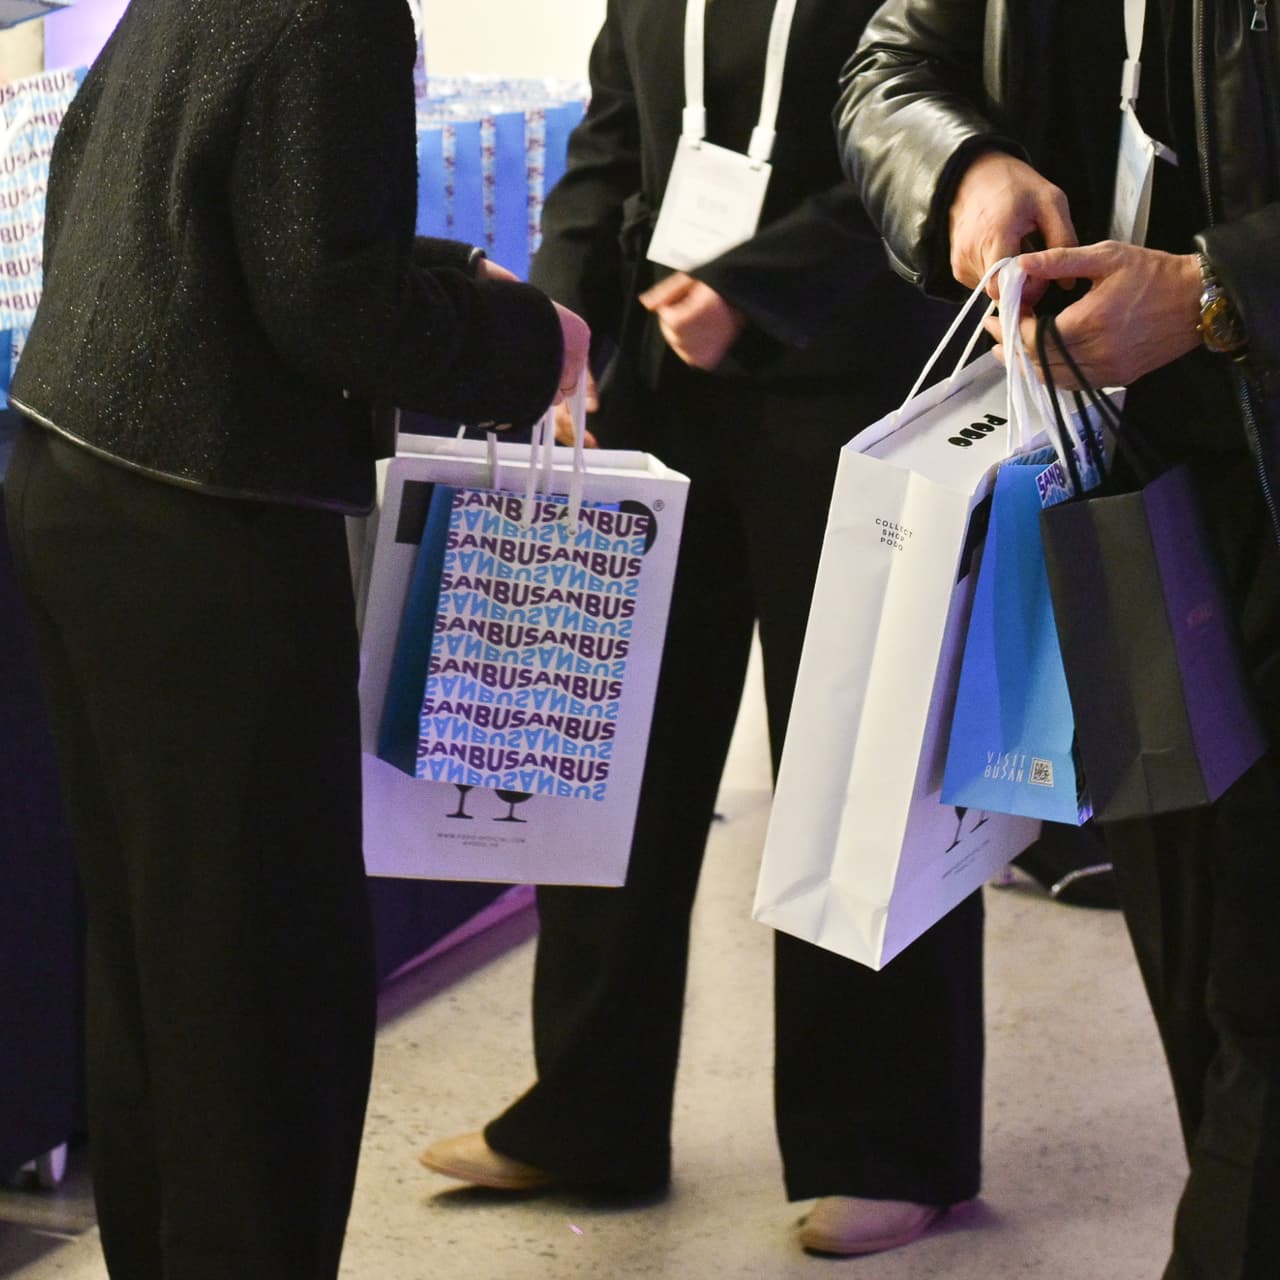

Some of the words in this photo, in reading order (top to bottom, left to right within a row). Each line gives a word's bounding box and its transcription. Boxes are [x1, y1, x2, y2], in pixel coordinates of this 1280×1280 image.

[947, 413, 1008, 448] PODO
[447, 531, 643, 579] SANBUSANBUS
[441, 573, 636, 620] SANBUSANBUS
[435, 614, 630, 661] SANBUSANBUS
[429, 656, 623, 702] SANBUSANBUS
[422, 698, 616, 742] SANBUSANBUS
[417, 739, 610, 784] SANBUSANBUS
[984, 765, 1025, 784] BUSAN
[986, 751, 1027, 769] VISIT
